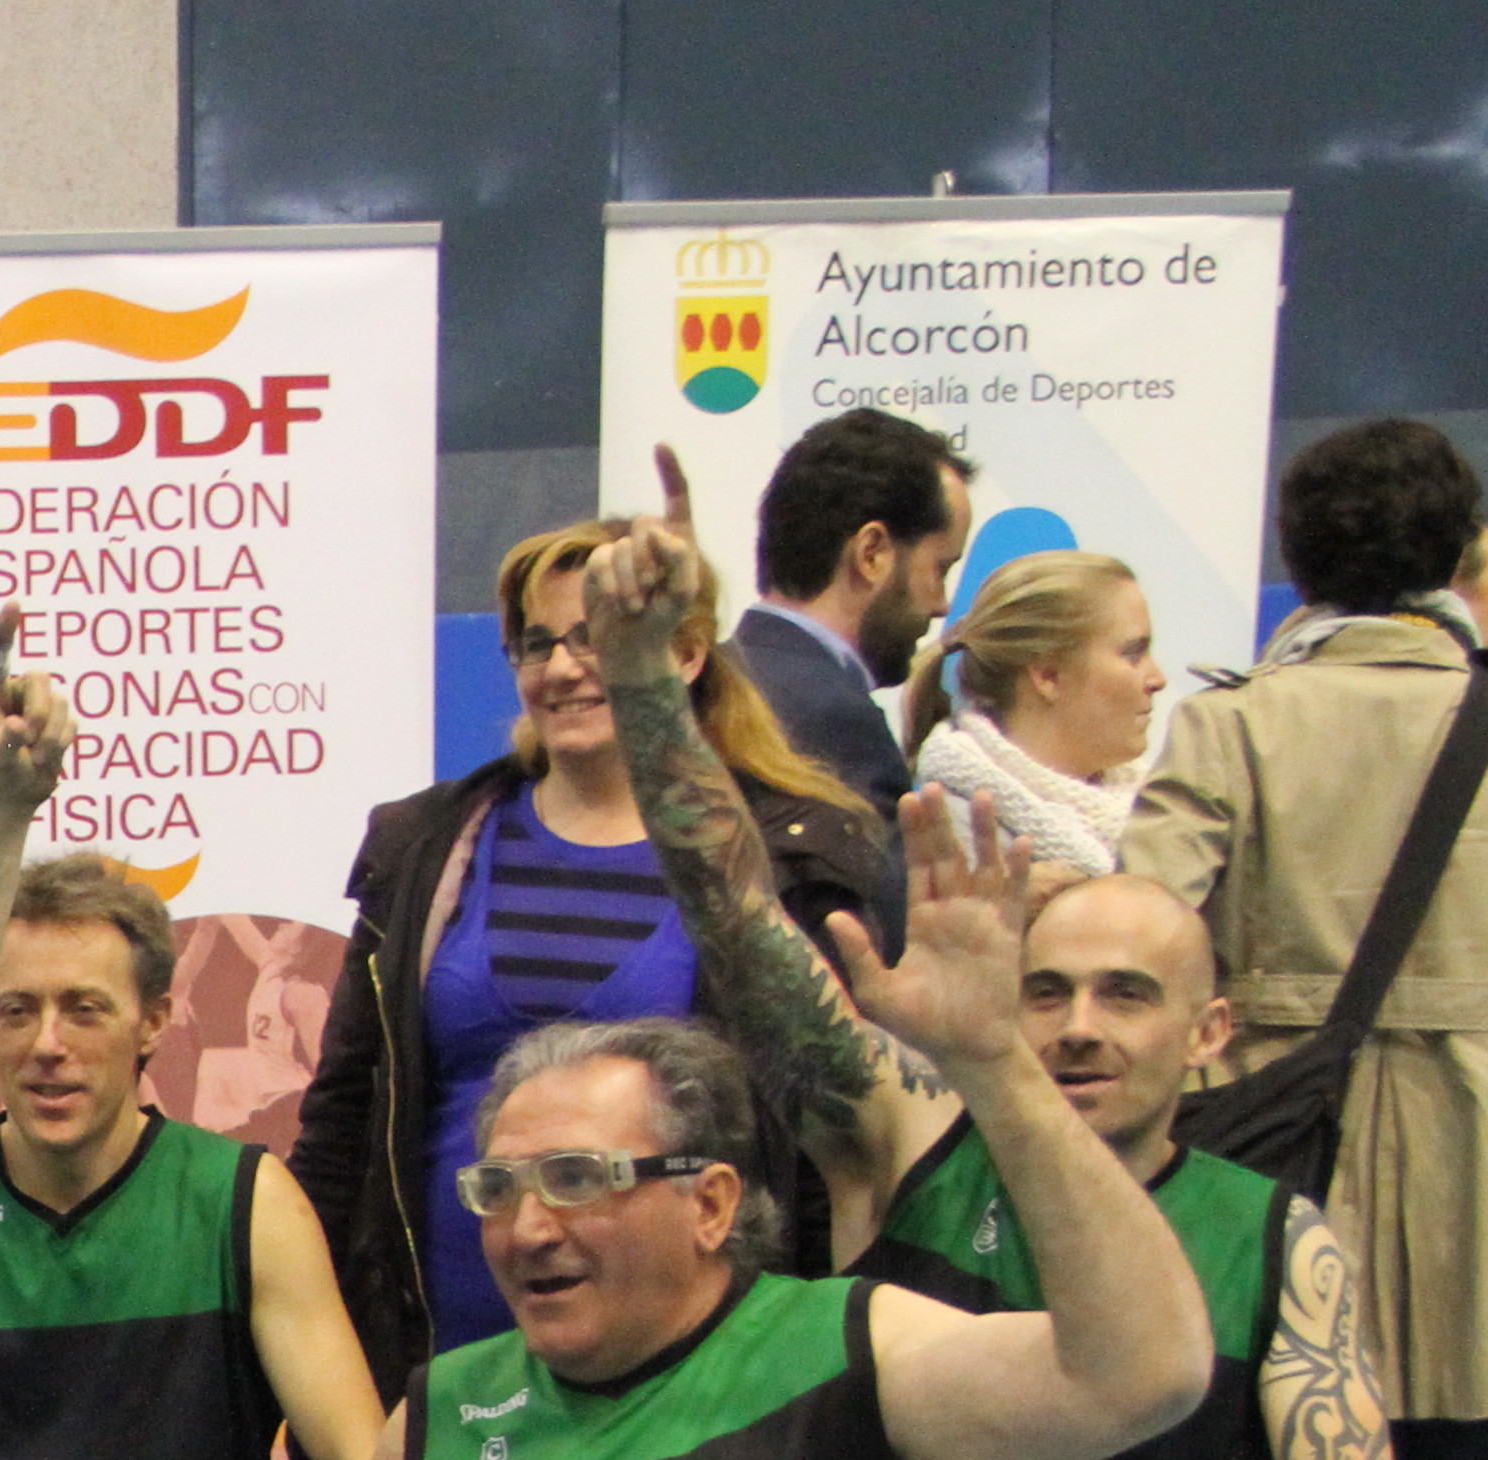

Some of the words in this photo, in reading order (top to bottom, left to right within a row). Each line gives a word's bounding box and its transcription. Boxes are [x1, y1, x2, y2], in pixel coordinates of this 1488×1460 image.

[816, 250, 1144, 306] Ayuntamiento
[1165, 243, 1217, 285] de
[815, 311, 1029, 357] Alcorcón
[813, 375, 969, 413] Concejalía
[982, 376, 1018, 404] de
[1031, 373, 1176, 410] Deportes
[248, 681, 326, 714] CON
